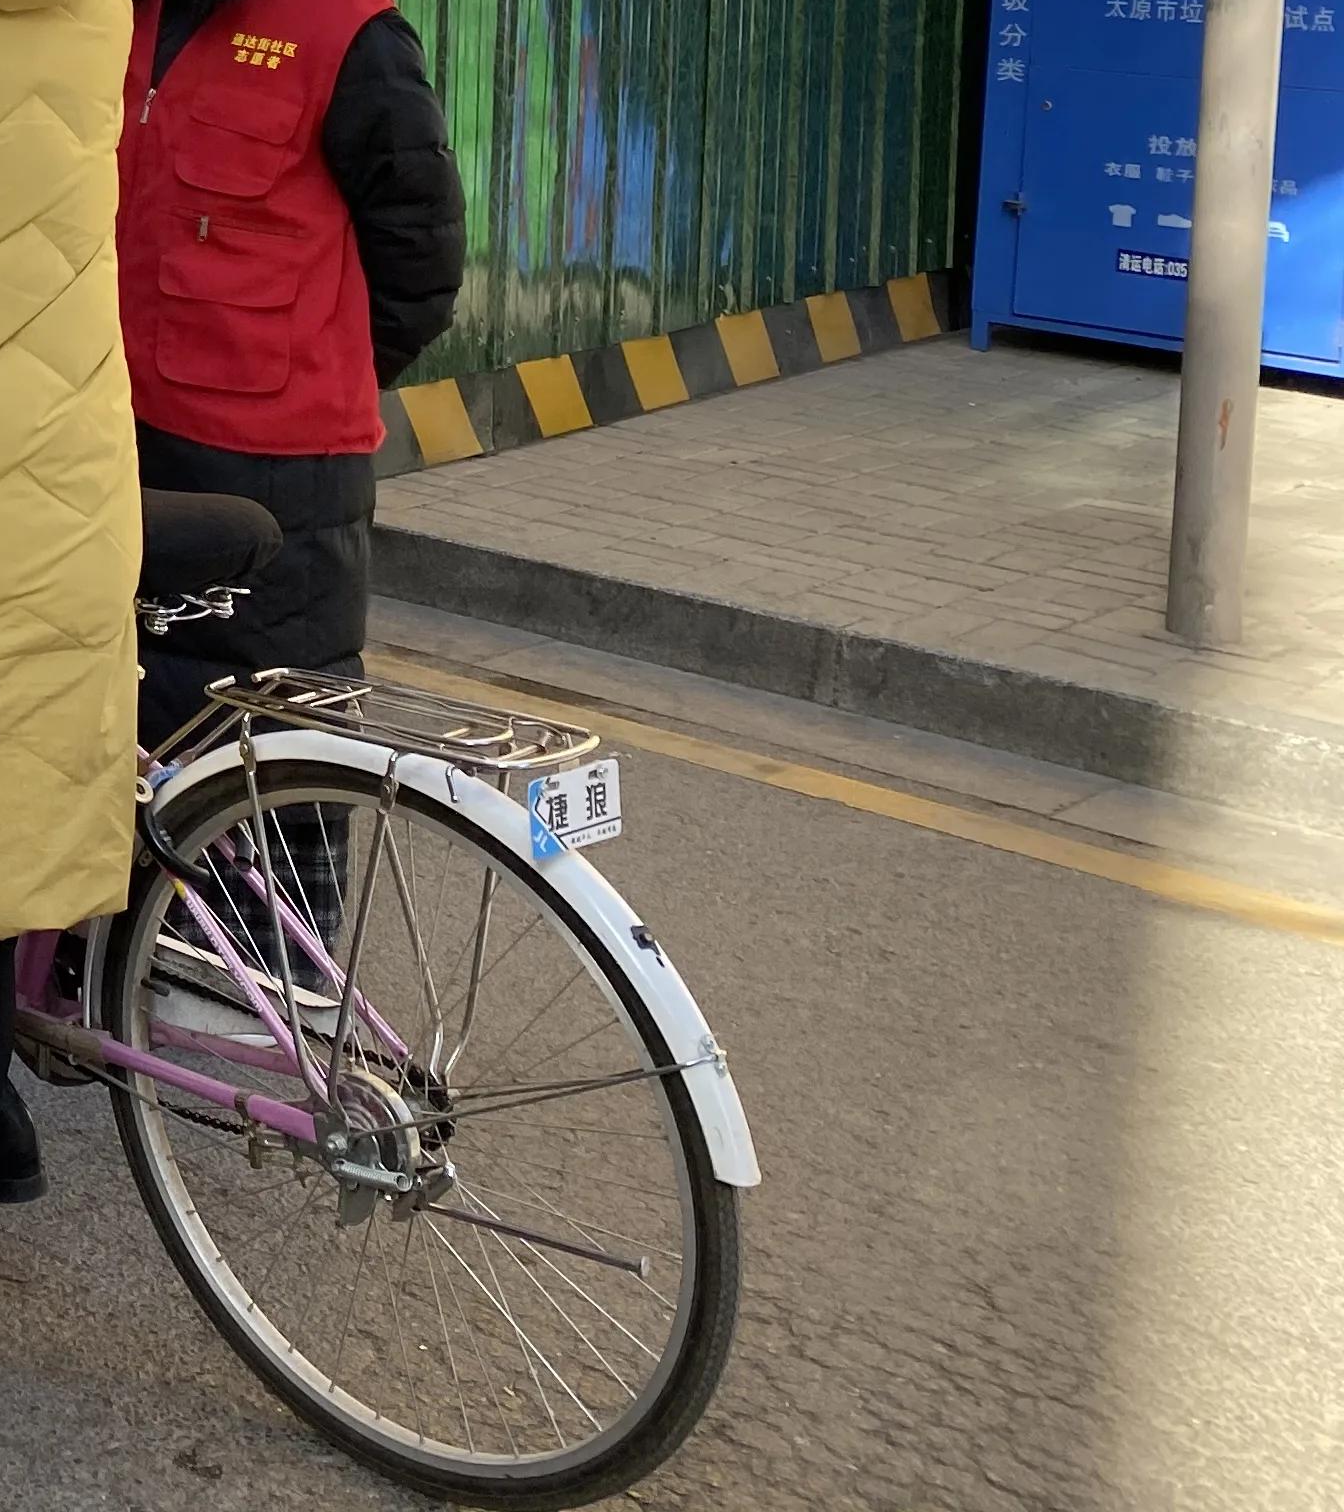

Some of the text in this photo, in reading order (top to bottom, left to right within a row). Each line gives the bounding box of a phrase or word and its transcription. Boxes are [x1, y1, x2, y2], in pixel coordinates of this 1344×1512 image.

[1284, 6, 1336, 33] 试点
[231, 32, 298, 58] 通达街社区
[234, 49, 281, 70] 志愿者
[1148, 134, 1196, 158] 投放
[1104, 162, 1141, 179] 衣服
